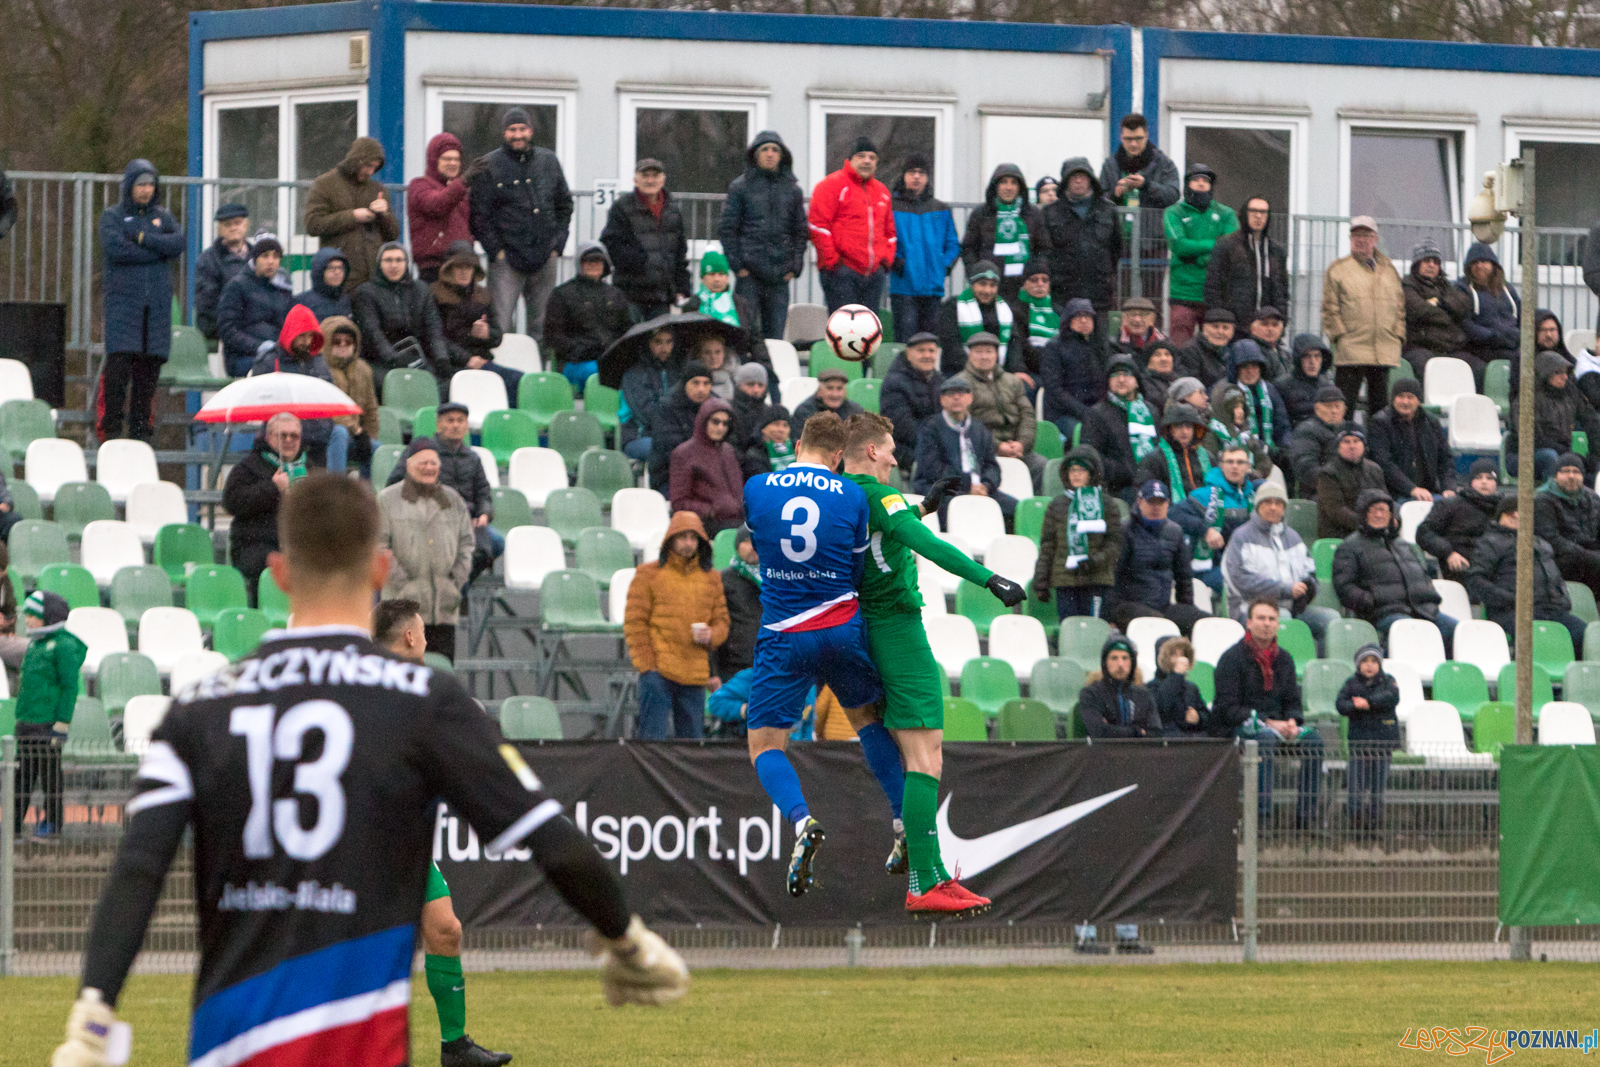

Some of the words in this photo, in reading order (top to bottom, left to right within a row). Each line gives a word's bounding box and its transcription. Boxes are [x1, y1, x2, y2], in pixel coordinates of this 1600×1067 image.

[596, 189, 616, 205] 31
[766, 471, 843, 494] KOMOR
[780, 496, 820, 563] 3
[229, 699, 354, 861] 13
